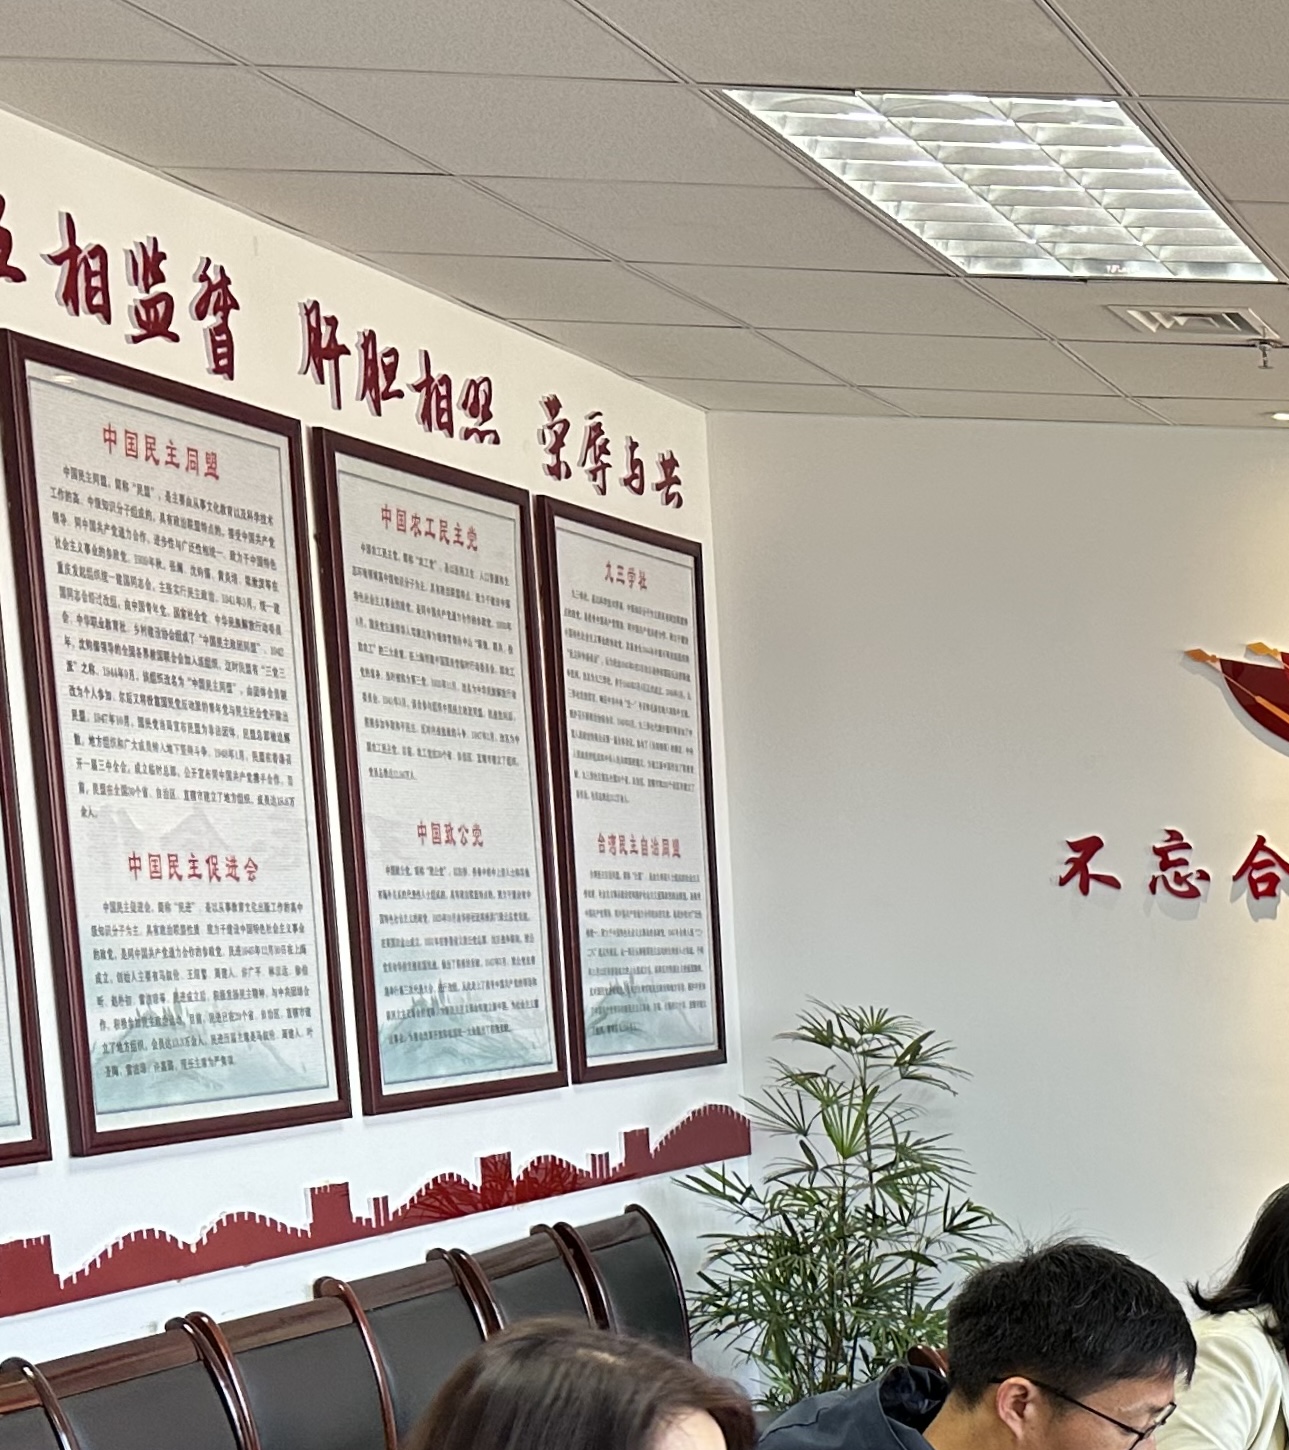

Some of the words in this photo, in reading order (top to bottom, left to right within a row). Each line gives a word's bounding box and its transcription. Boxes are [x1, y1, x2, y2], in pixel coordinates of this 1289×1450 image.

[303, 301, 496, 442] 肝胆相照
[541, 397, 683, 508] 荣辱与共
[103, 423, 219, 480] 中国民主同盟
[381, 504, 478, 552] 中国农工民主党
[605, 561, 648, 590] 九三学社
[417, 821, 484, 848] 中国致公党
[597, 832, 681, 858] 台湾民主自治同盟
[128, 851, 259, 882] 中国民主促进会
